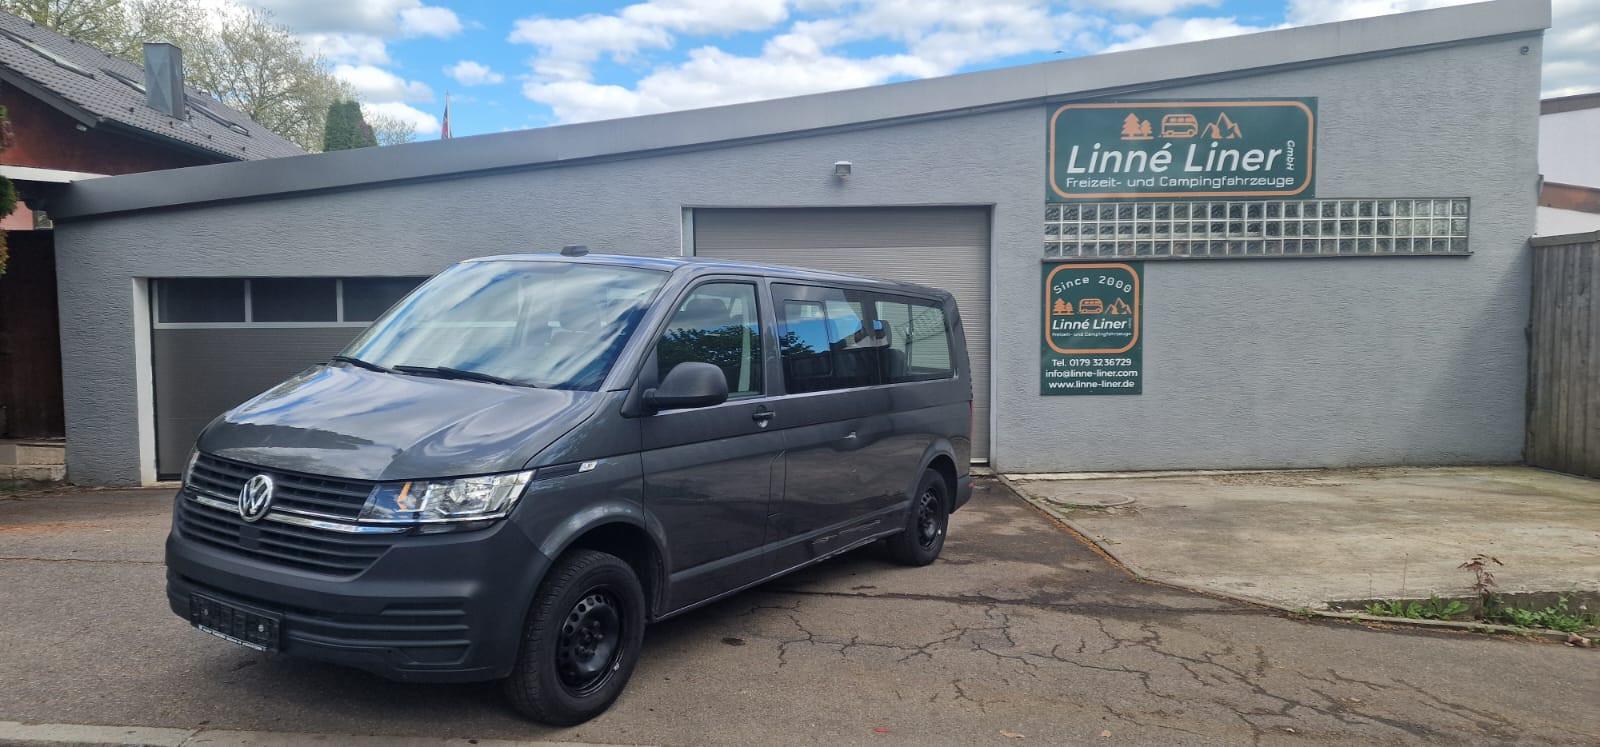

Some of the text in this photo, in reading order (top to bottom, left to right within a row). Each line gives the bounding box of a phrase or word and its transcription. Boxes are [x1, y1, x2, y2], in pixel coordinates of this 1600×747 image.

[1066, 141, 1282, 173] Linné Liner
[1287, 140, 1296, 170] GmbH
[1066, 176, 1295, 188] Freizeit- und Campingfahrzeuge
[1053, 275, 1132, 294] Since 2000
[1052, 318, 1089, 330] Linné
[1093, 318, 1127, 330] Liner
[1069, 358, 1090, 366] 0179
[1093, 358, 1132, 366] 3236729
[1045, 369, 1138, 378] info@linne-liner.com
[1048, 379, 1135, 388] www.linne-liner.de
